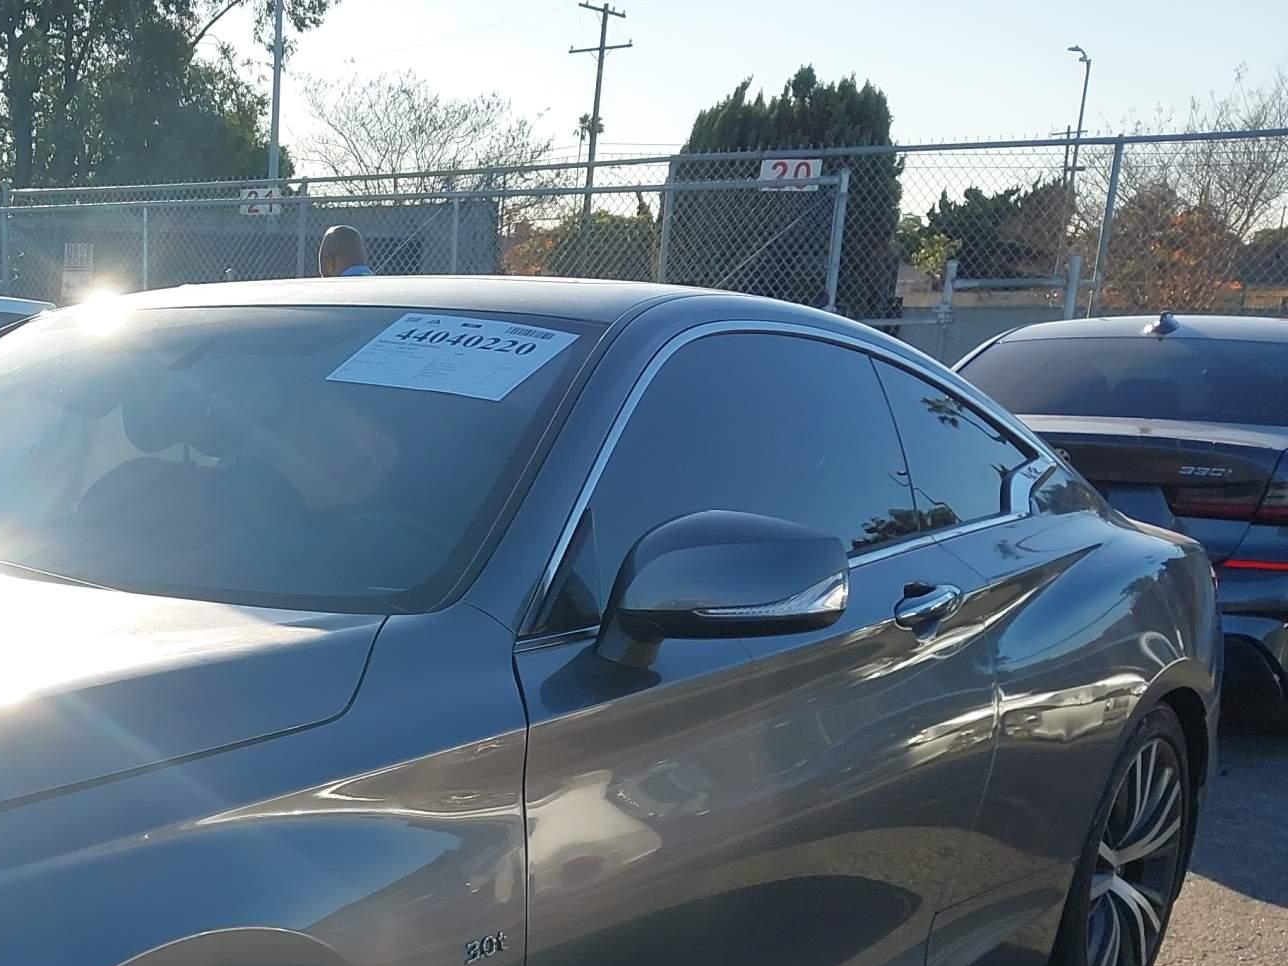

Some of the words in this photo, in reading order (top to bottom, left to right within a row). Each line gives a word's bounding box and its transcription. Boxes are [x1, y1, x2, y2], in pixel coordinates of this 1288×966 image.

[772, 161, 811, 188] 20
[248, 190, 273, 213] 21
[396, 328, 538, 356] 44040220
